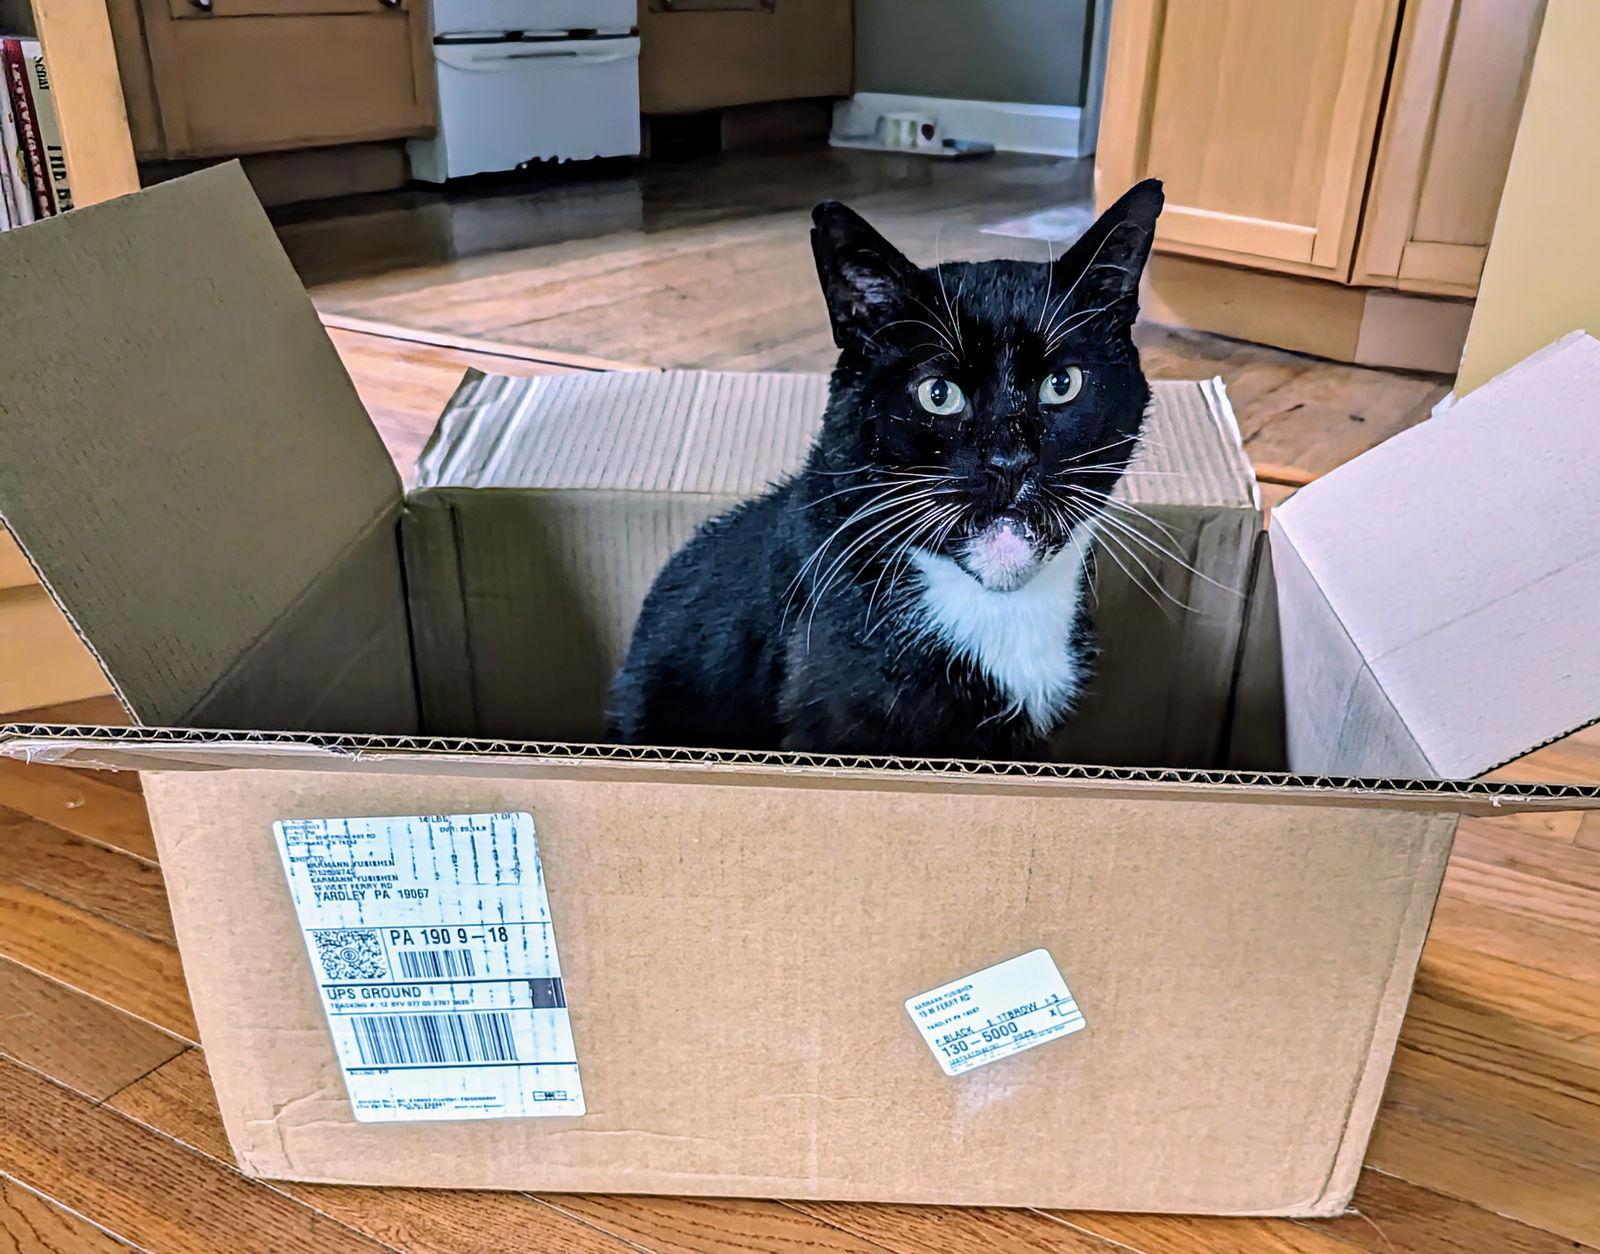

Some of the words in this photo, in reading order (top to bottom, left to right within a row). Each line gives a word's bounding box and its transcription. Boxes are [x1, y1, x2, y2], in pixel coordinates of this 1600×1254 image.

[314, 890, 366, 901] YARDLEY
[375, 889, 391, 900] PA
[398, 888, 430, 899] 19067
[390, 929, 415, 946] PA
[421, 928, 451, 945] 190
[327, 987, 356, 1000] UPS
[361, 986, 421, 999] GROUND
